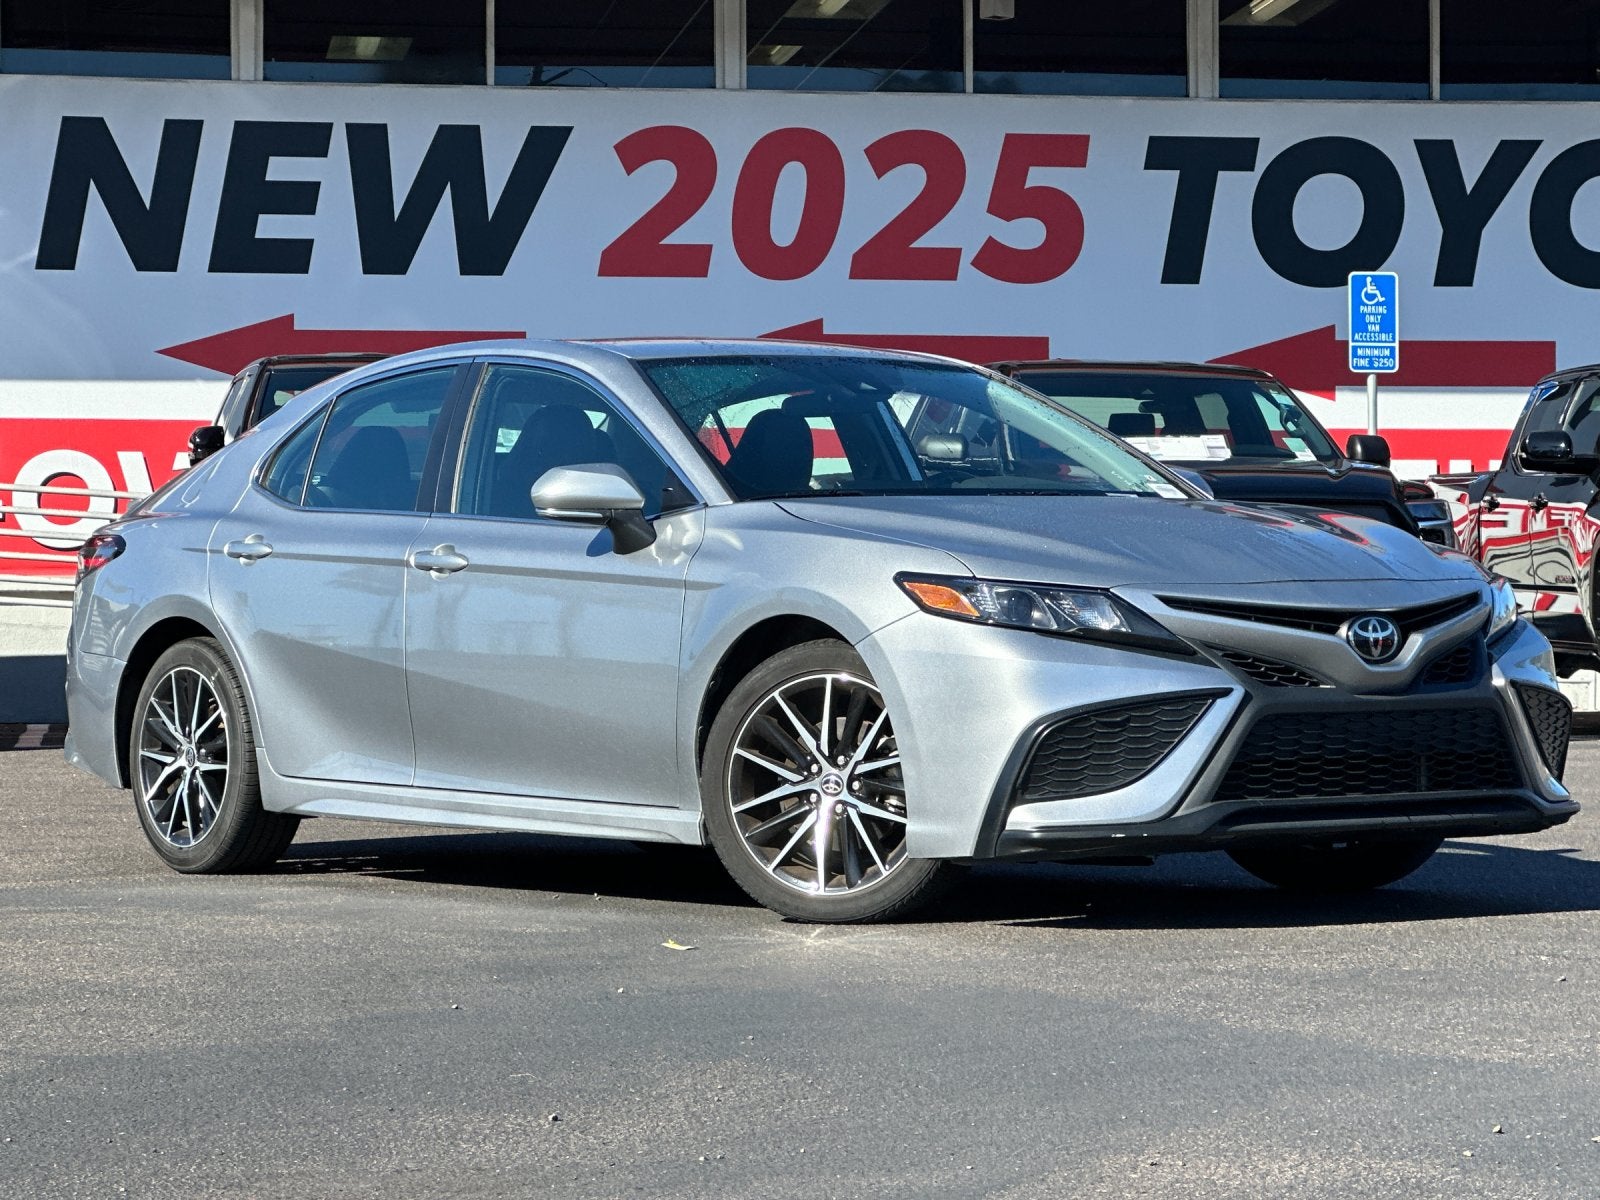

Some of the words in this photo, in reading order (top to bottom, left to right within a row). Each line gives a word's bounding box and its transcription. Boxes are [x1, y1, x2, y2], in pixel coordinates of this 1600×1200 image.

[36, 116, 574, 276] NEW
[598, 126, 1090, 284] 2025
[1359, 305, 1387, 314] PARKING
[1365, 314, 1382, 323] ONLY
[1367, 324, 1380, 333] VAN
[1353, 332, 1394, 342] ACCESSIBLE
[1357, 347, 1391, 357] MINIMUM
[1353, 358, 1370, 368] FINE
[1373, 357, 1394, 368] $250
